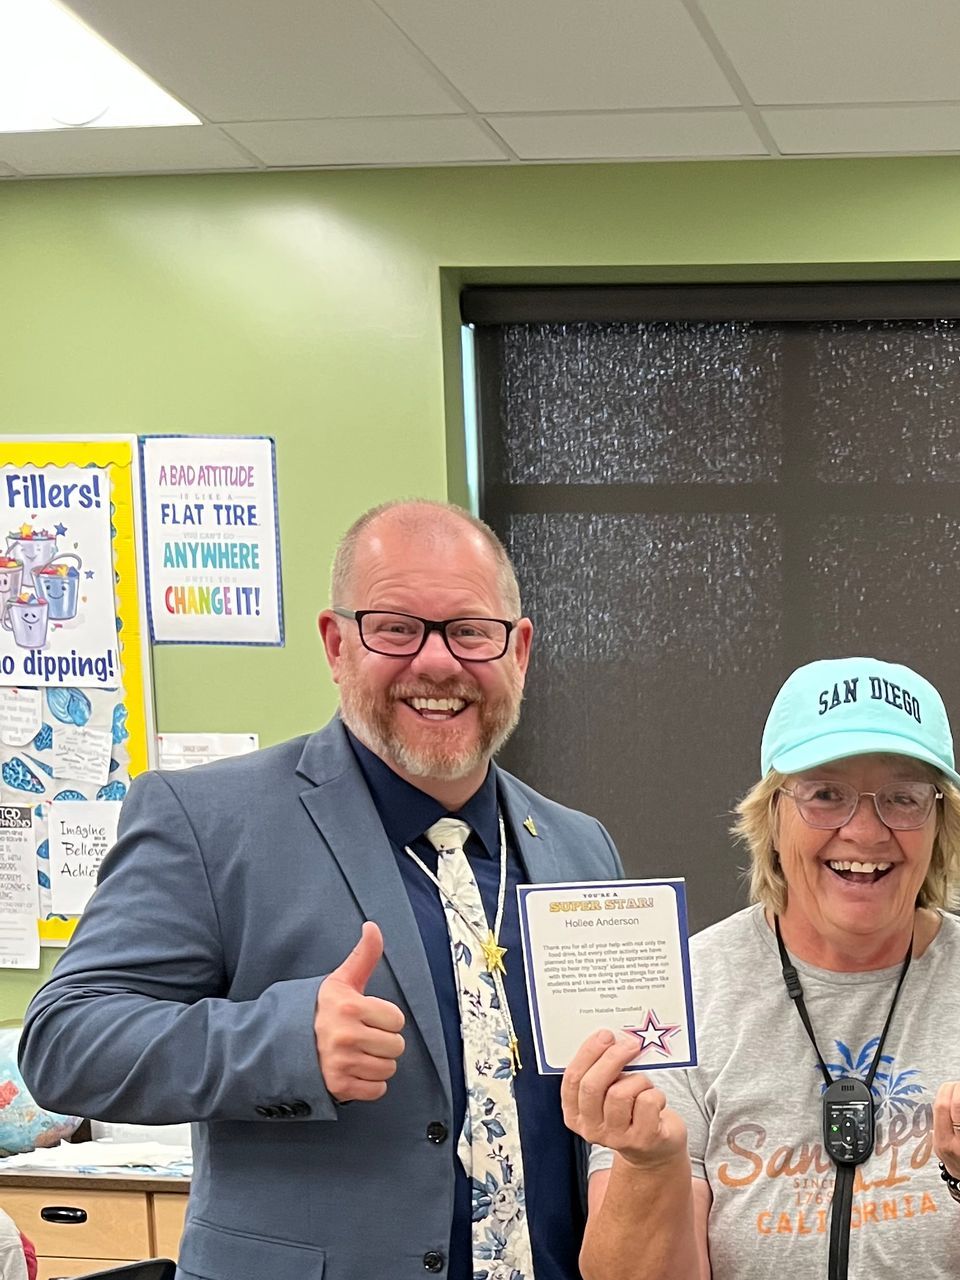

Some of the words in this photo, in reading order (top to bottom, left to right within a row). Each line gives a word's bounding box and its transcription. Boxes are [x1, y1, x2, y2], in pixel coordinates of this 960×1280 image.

[159, 465, 168, 486] A
[170, 465, 196, 486] BAD
[198, 465, 254, 487] ATTITUDE
[6, 474, 101, 509] Fillers!
[161, 503, 204, 525] FLAT
[164, 542, 260, 570] ANYWHERE
[165, 586, 232, 615] CHANGE
[236, 587, 260, 616] IT!
[0, 656, 14, 674] o
[24, 650, 114, 682] dipping!
[818, 677, 859, 715] SAN
[869, 676, 922, 724] DIEGO
[60, 820, 106, 838] Imagine
[61, 842, 106, 856] Believe
[60, 862, 98, 878] Achie
[549, 900, 602, 912] SUPER
[604, 898, 654, 910] STAR!
[596, 918, 640, 926] Anderson
[718, 1124, 832, 1188] San
[756, 1191, 938, 1236] CALIORNIA
